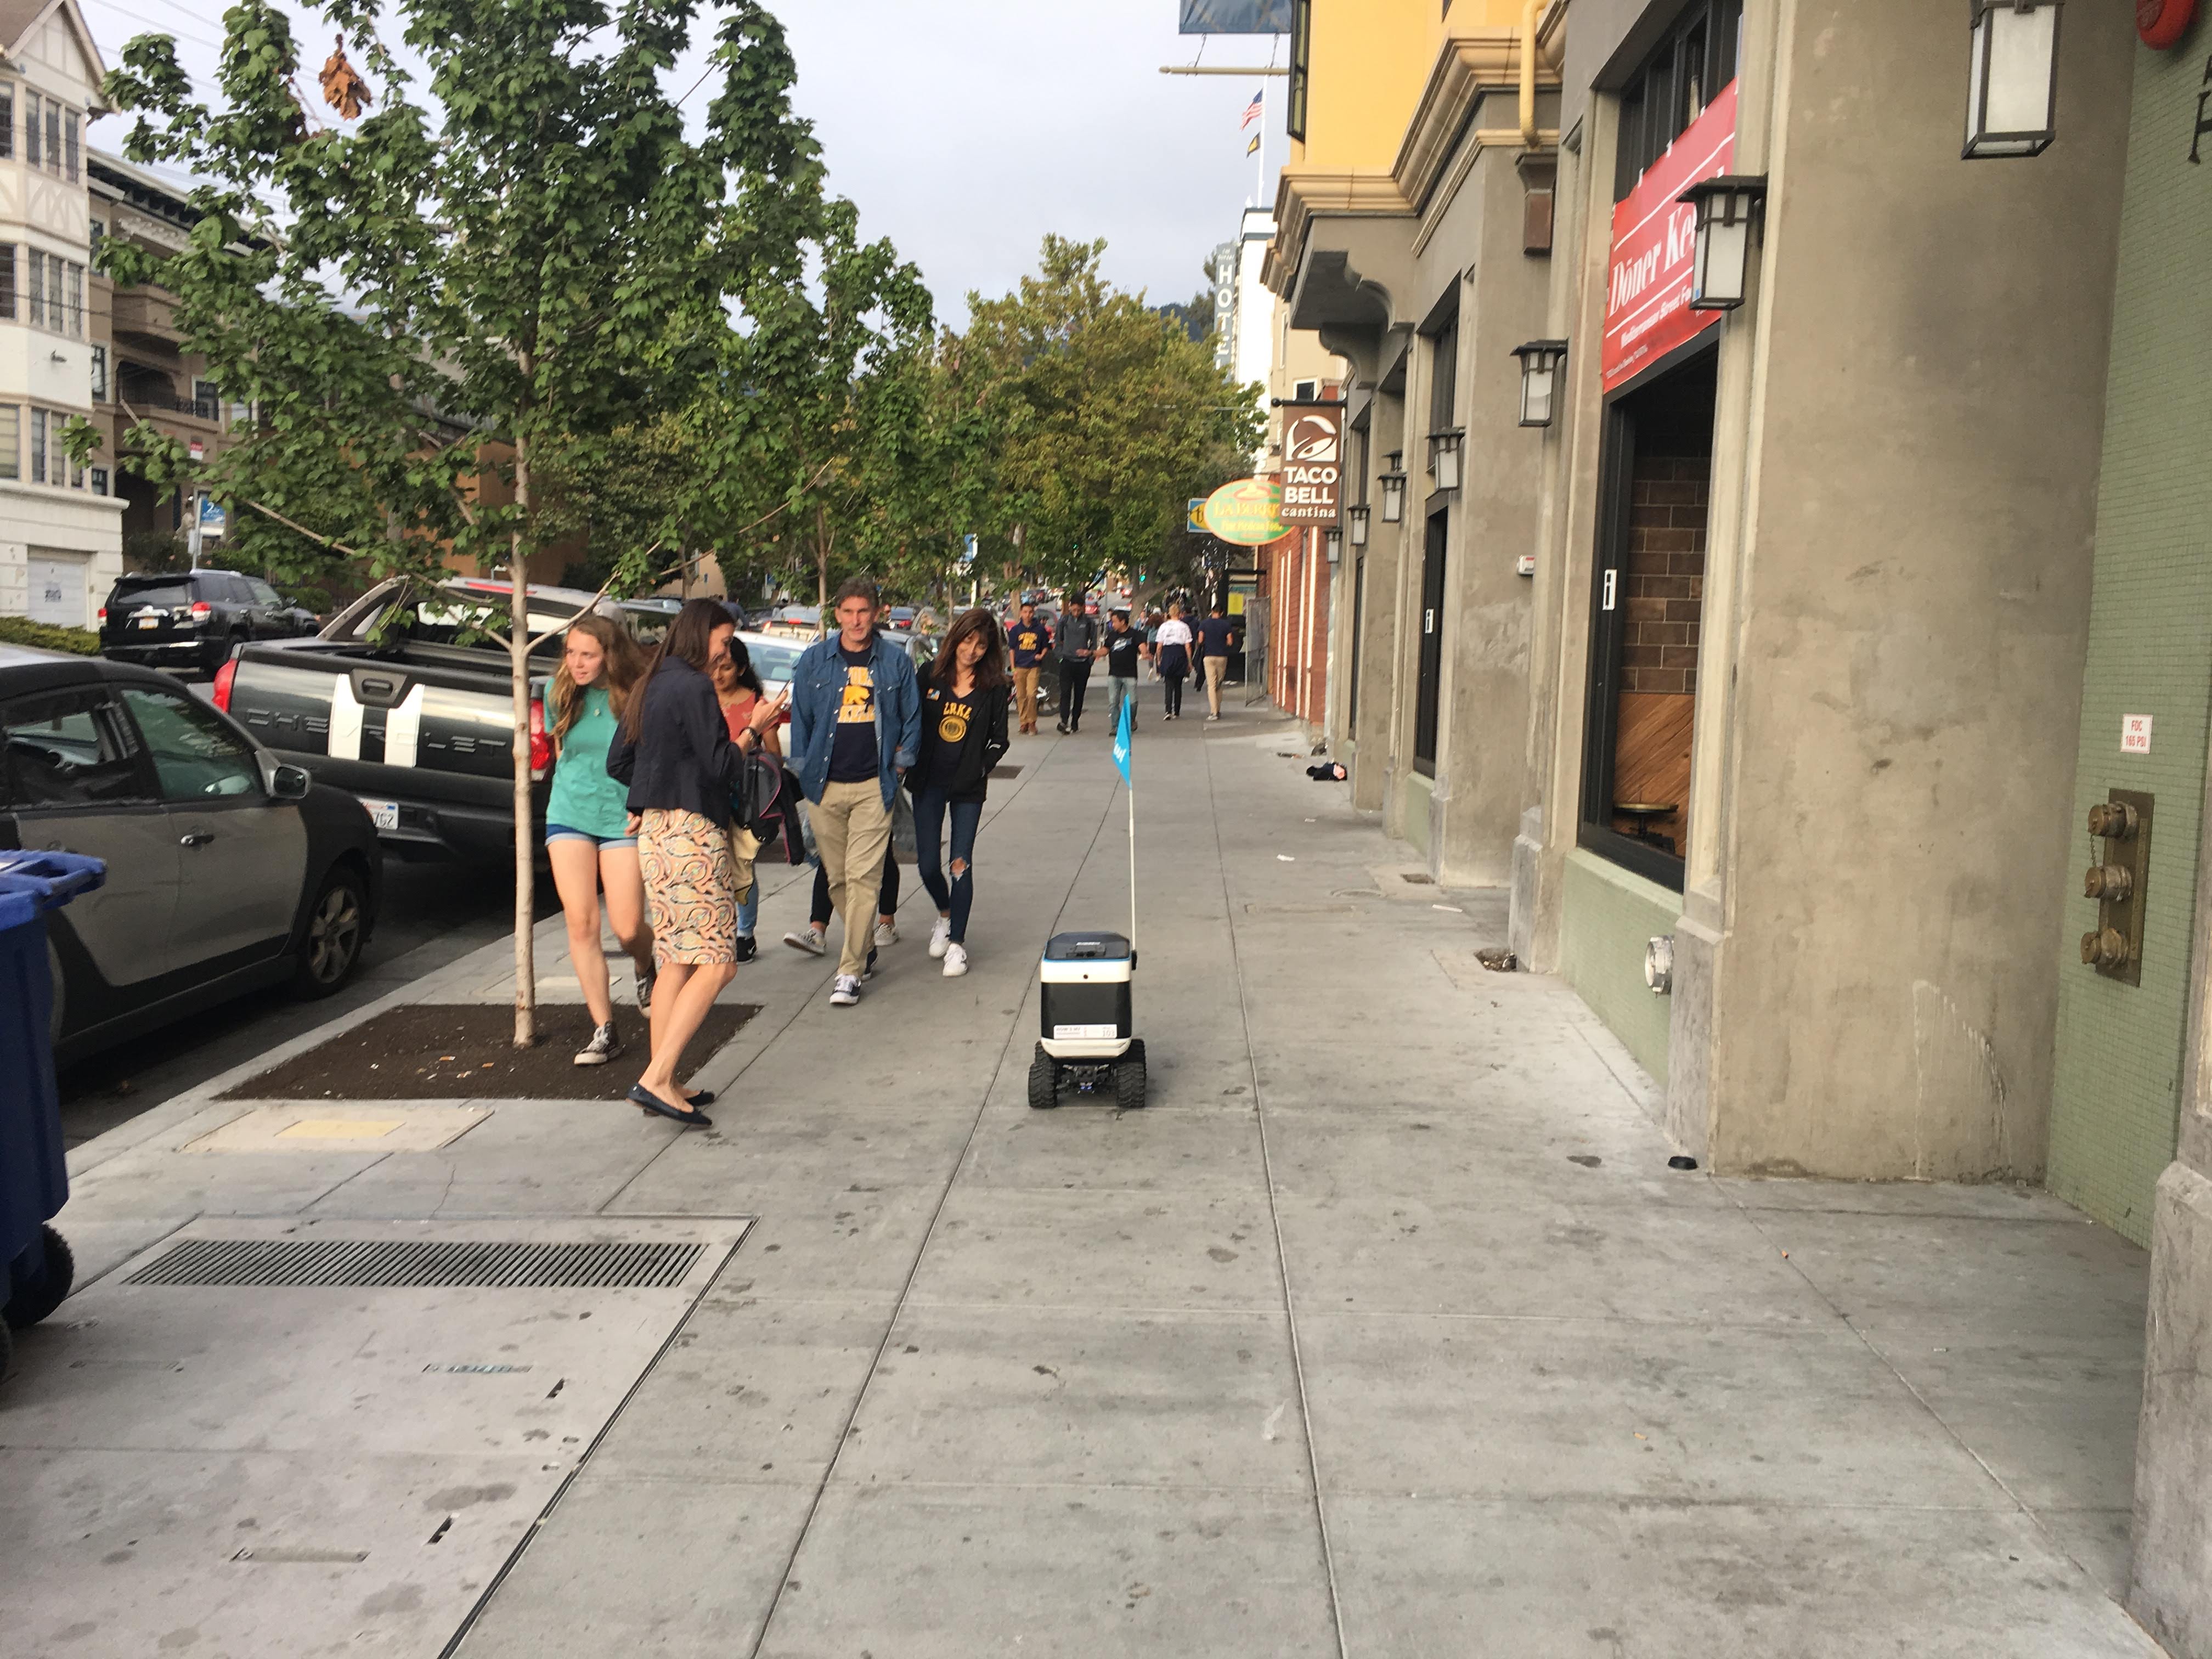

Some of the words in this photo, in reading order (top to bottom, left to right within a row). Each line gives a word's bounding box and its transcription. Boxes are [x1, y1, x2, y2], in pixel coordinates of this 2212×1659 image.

[1608, 239, 1662, 318] Döner
[1283, 466, 1338, 484] TACO
[1284, 487, 1334, 504] BELL
[1282, 506, 1336, 518] cantina
[2131, 719, 2142, 731] FDC
[2137, 736, 2146, 747] PSI
